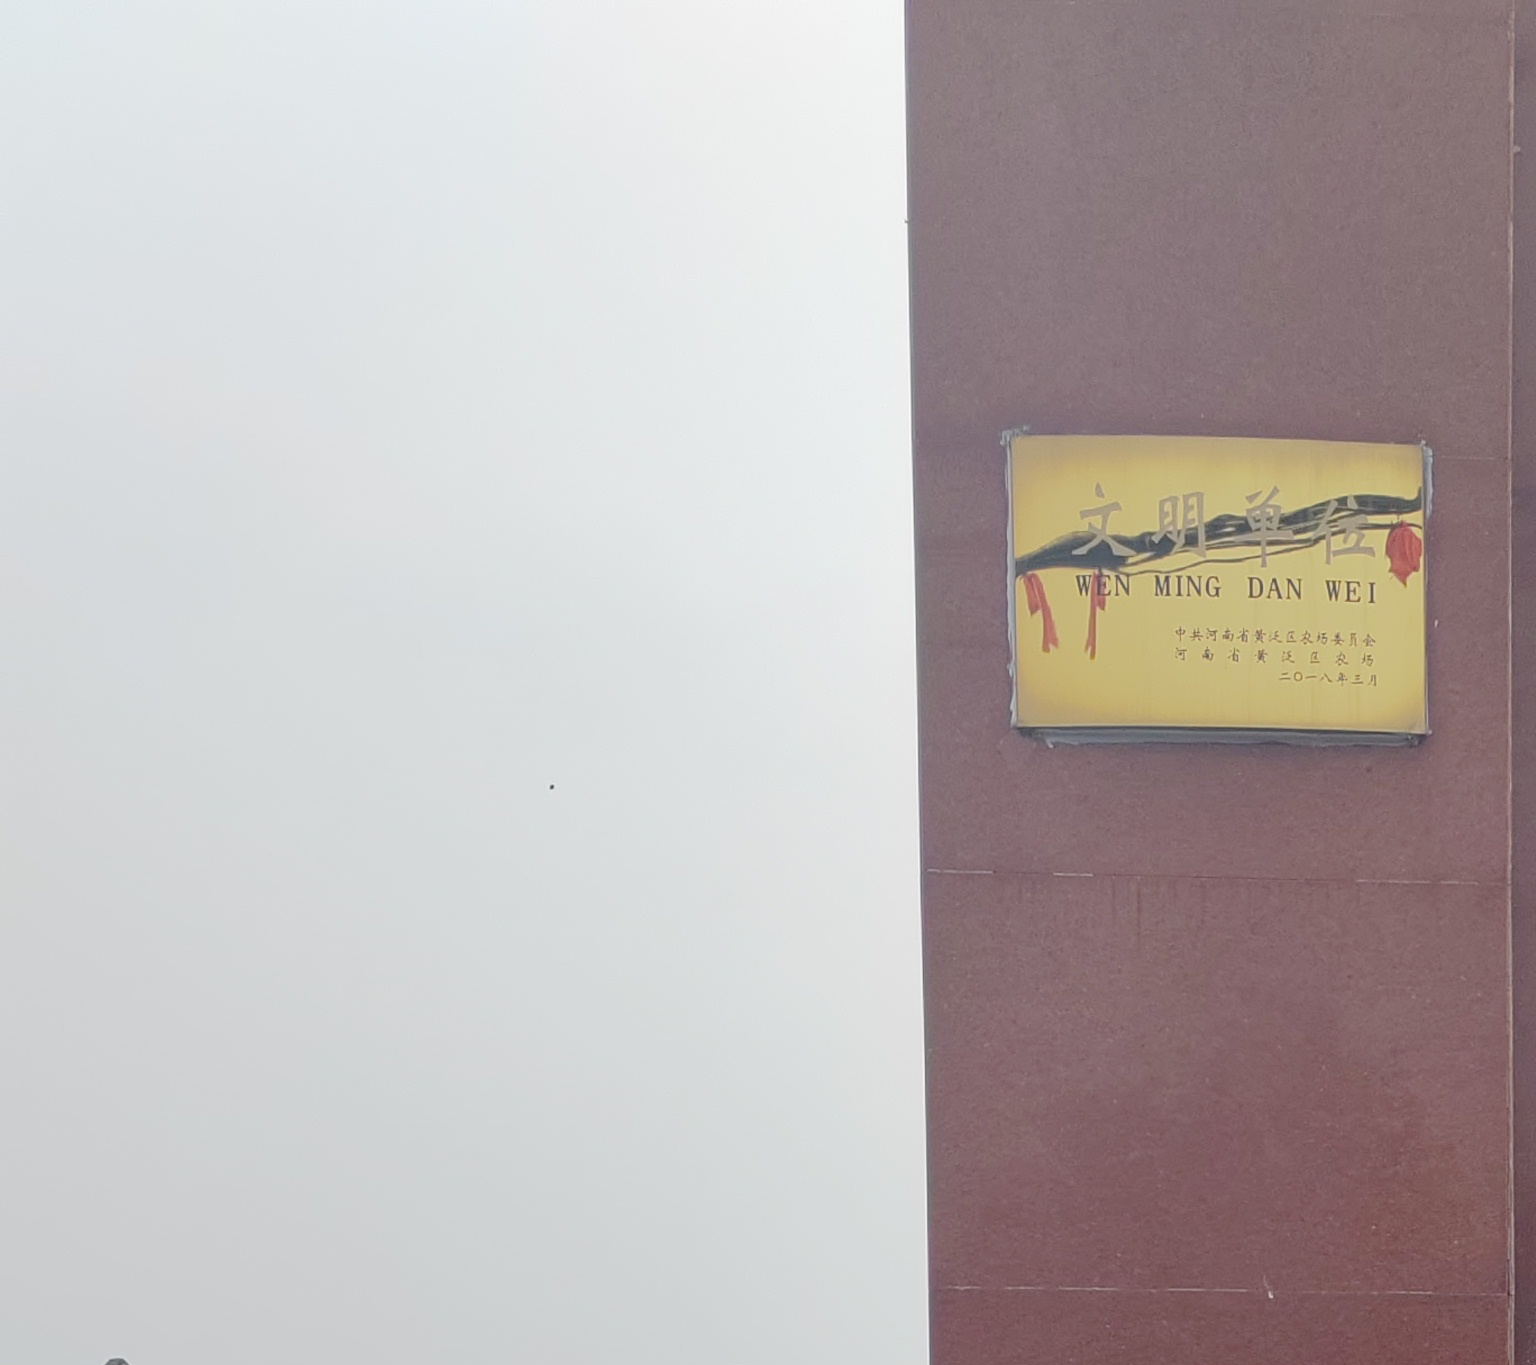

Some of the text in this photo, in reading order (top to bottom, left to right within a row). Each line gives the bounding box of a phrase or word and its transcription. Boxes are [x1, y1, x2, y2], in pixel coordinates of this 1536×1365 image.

[1071, 482, 1376, 568] 文明单位
[1075, 574, 1376, 604] WEN MING DAN WEI
[1175, 626, 1377, 648] 中共河南省黄泛区农场委员会
[1175, 647, 1375, 667] 河南省黄泛区农场
